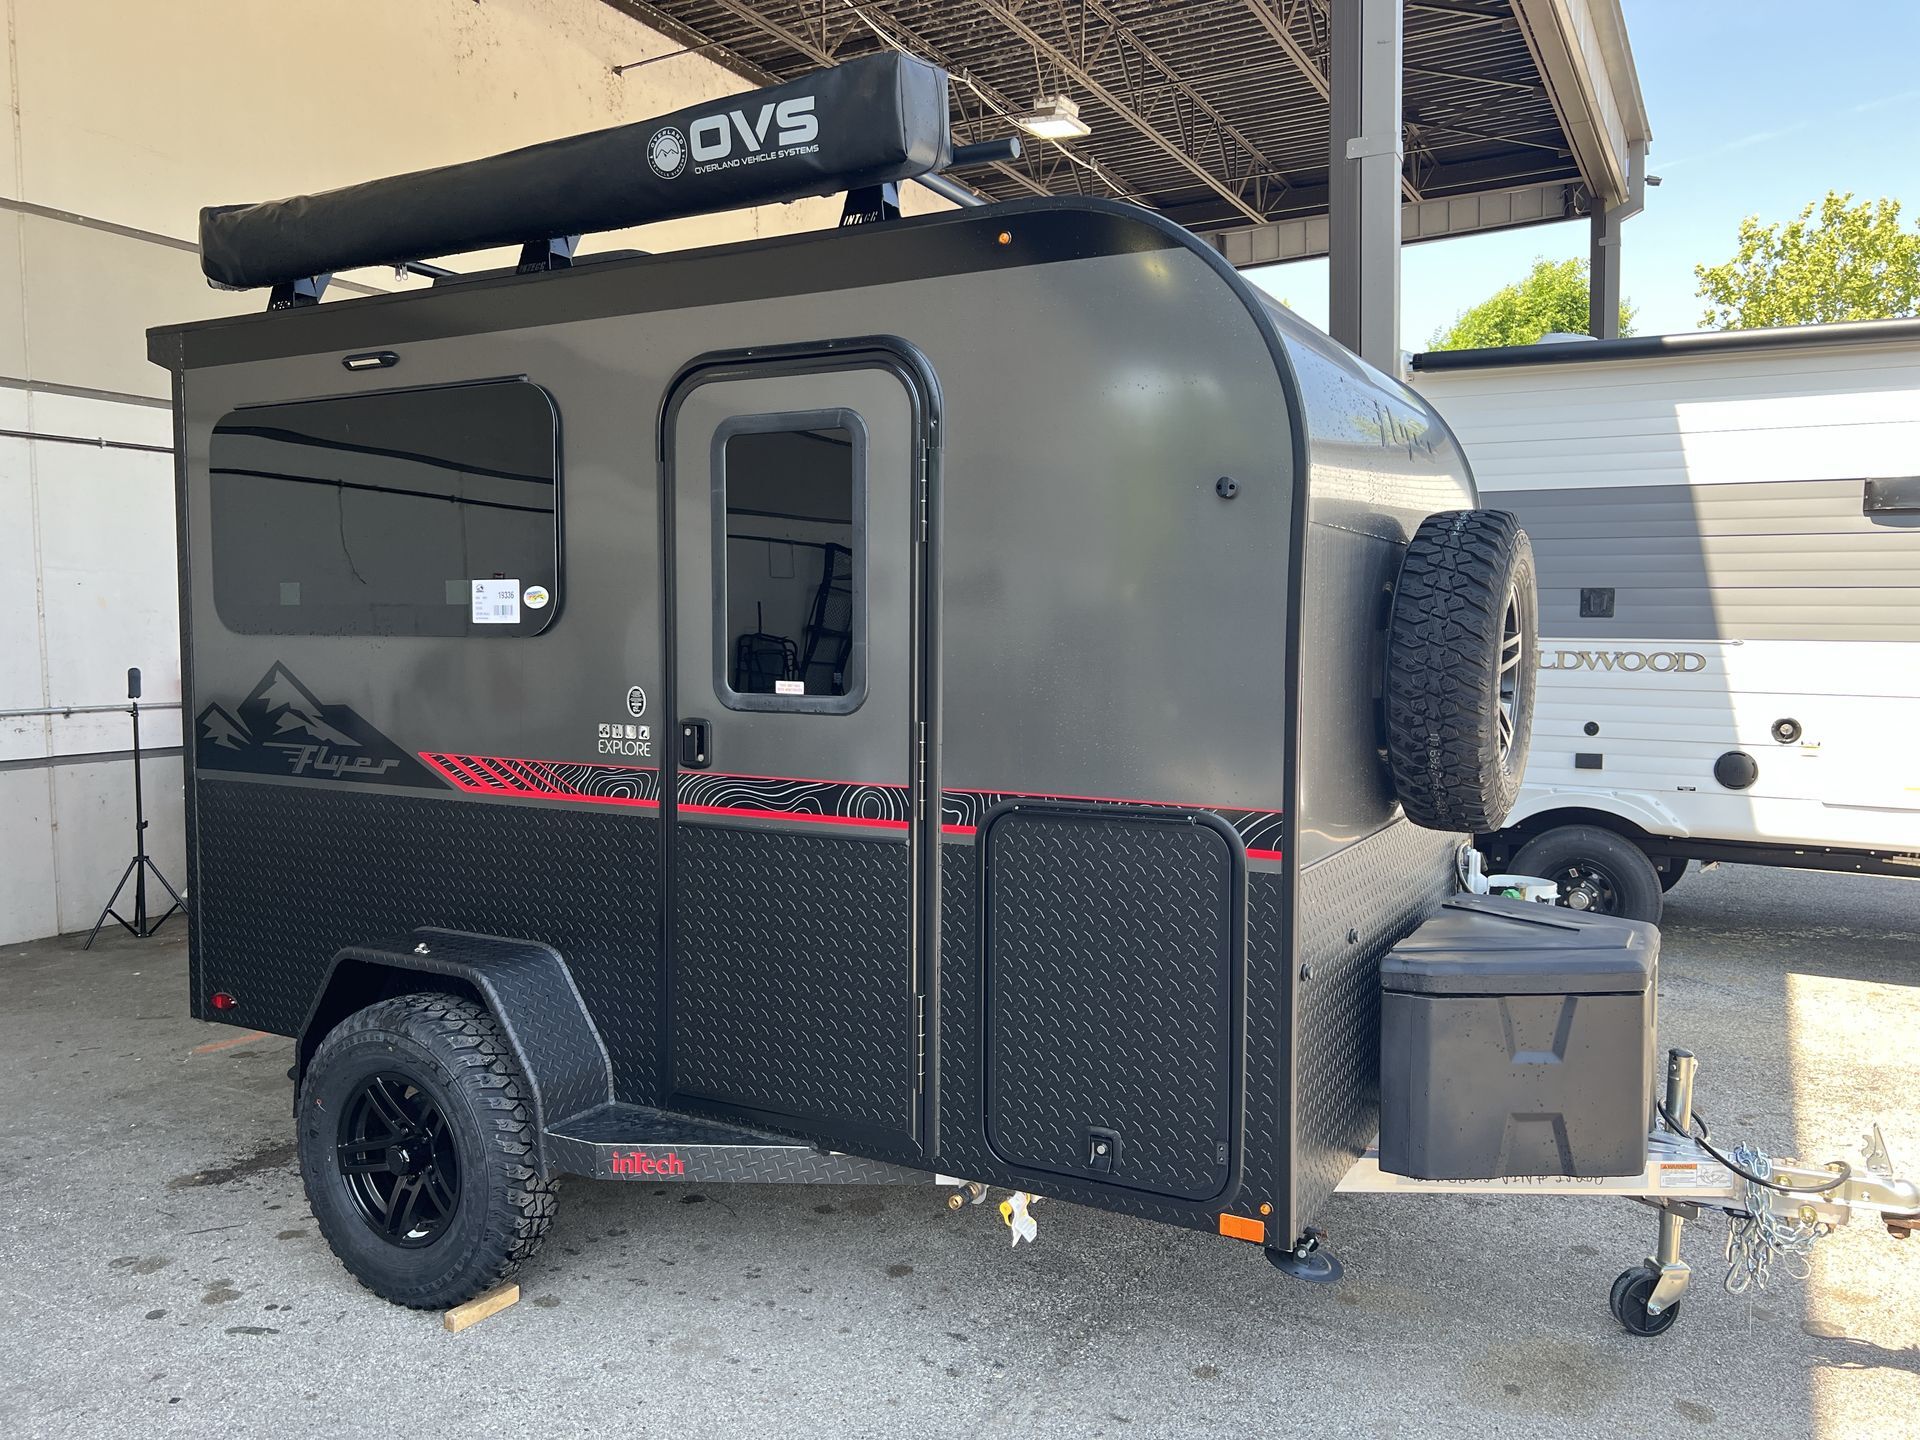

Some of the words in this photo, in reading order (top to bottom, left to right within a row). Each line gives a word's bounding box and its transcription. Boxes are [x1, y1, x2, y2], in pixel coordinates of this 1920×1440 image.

[690, 96, 819, 162] OVS
[694, 158, 741, 174] OVERLAND
[741, 151, 777, 165] VEHICLE
[778, 144, 819, 158] SYSTEMS
[1536, 650, 1707, 673] LDWOOD
[598, 739, 652, 757] EXPLORE
[612, 1151, 685, 1175] inTech
